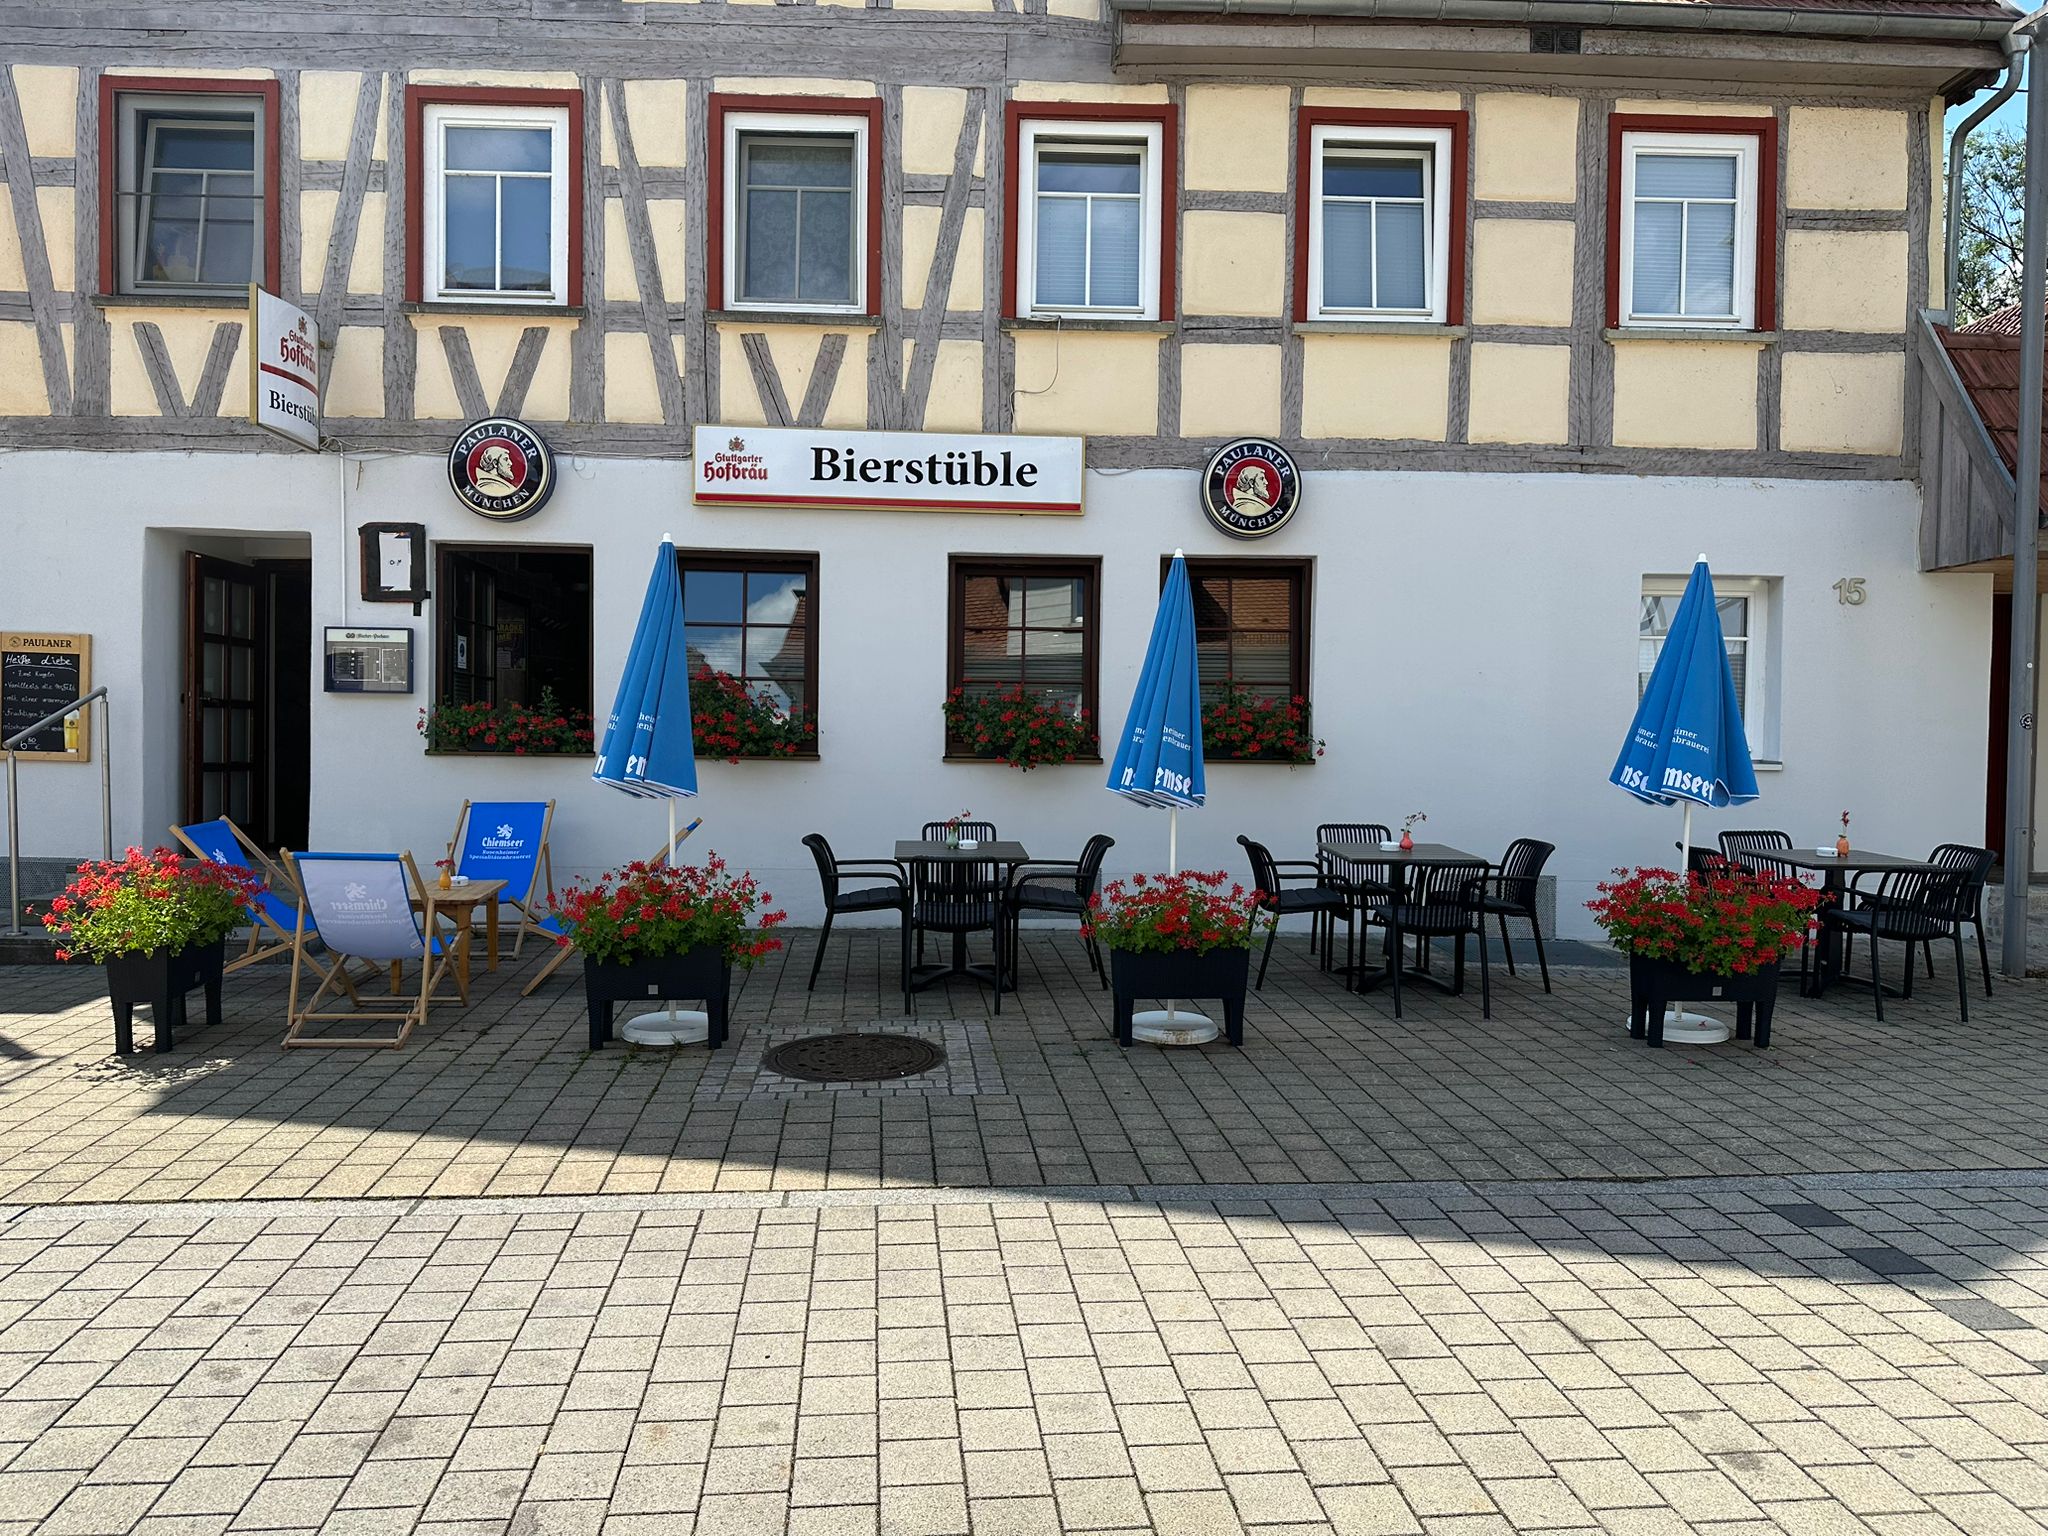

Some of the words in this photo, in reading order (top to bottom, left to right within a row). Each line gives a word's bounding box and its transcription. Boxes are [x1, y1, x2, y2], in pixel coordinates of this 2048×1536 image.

[280, 337, 316, 374] Hofbräu
[458, 426, 537, 459] PAULANER
[715, 452, 763, 465] Stuttgarter
[809, 446, 1038, 488] Bierstüble
[1215, 445, 1291, 478] PAULANER
[704, 461, 768, 482] Hofbräu
[1220, 505, 1284, 528] MÜNCHEN
[1832, 577, 1866, 605] 15
[23, 638, 72, 648] PAULANER
[41, 655, 72, 666] Liebe
[482, 837, 524, 847] Chiemseer
